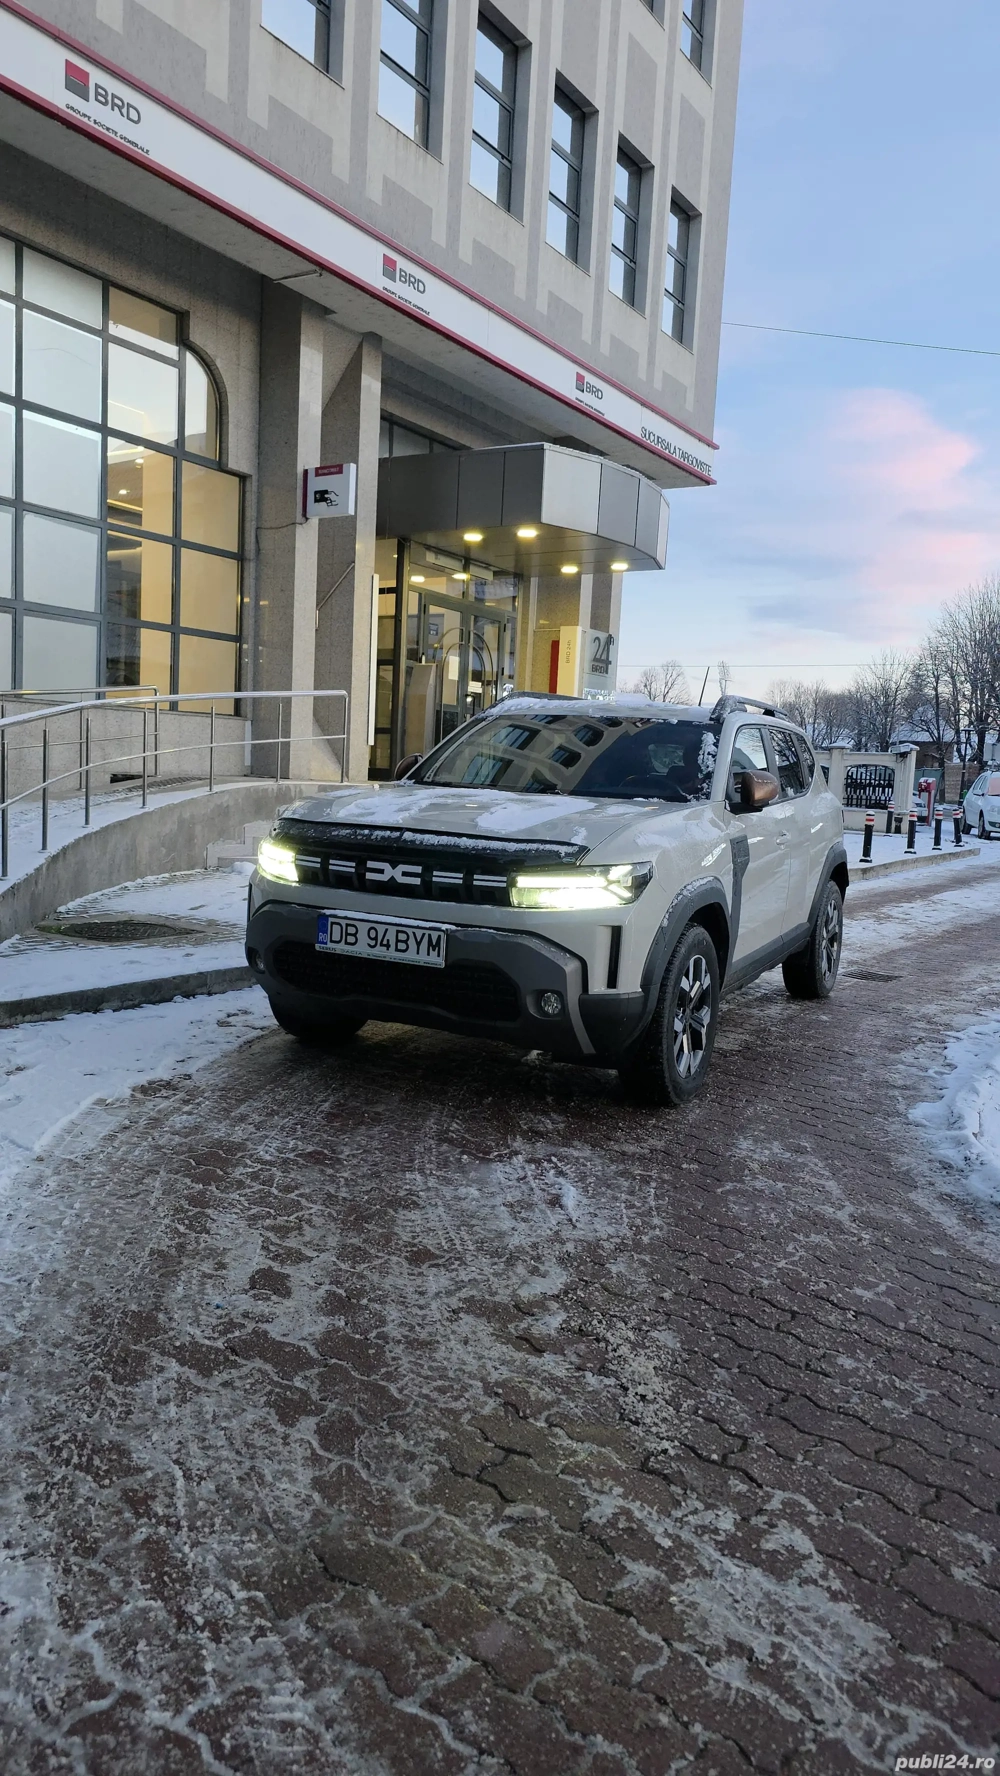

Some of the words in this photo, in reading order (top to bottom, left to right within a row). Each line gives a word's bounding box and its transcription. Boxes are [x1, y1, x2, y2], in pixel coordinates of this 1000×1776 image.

[94, 82, 142, 125] BRD
[65, 103, 92, 122] GROUPE
[119, 134, 150, 155] GENERALE
[399, 267, 426, 295] BRD
[585, 380, 604, 400] BRD
[640, 426, 677, 458] SUCURSALA
[677, 447, 712, 477] TARGOVISTE
[318, 932, 328, 943] RO
[329, 921, 359, 946] DB
